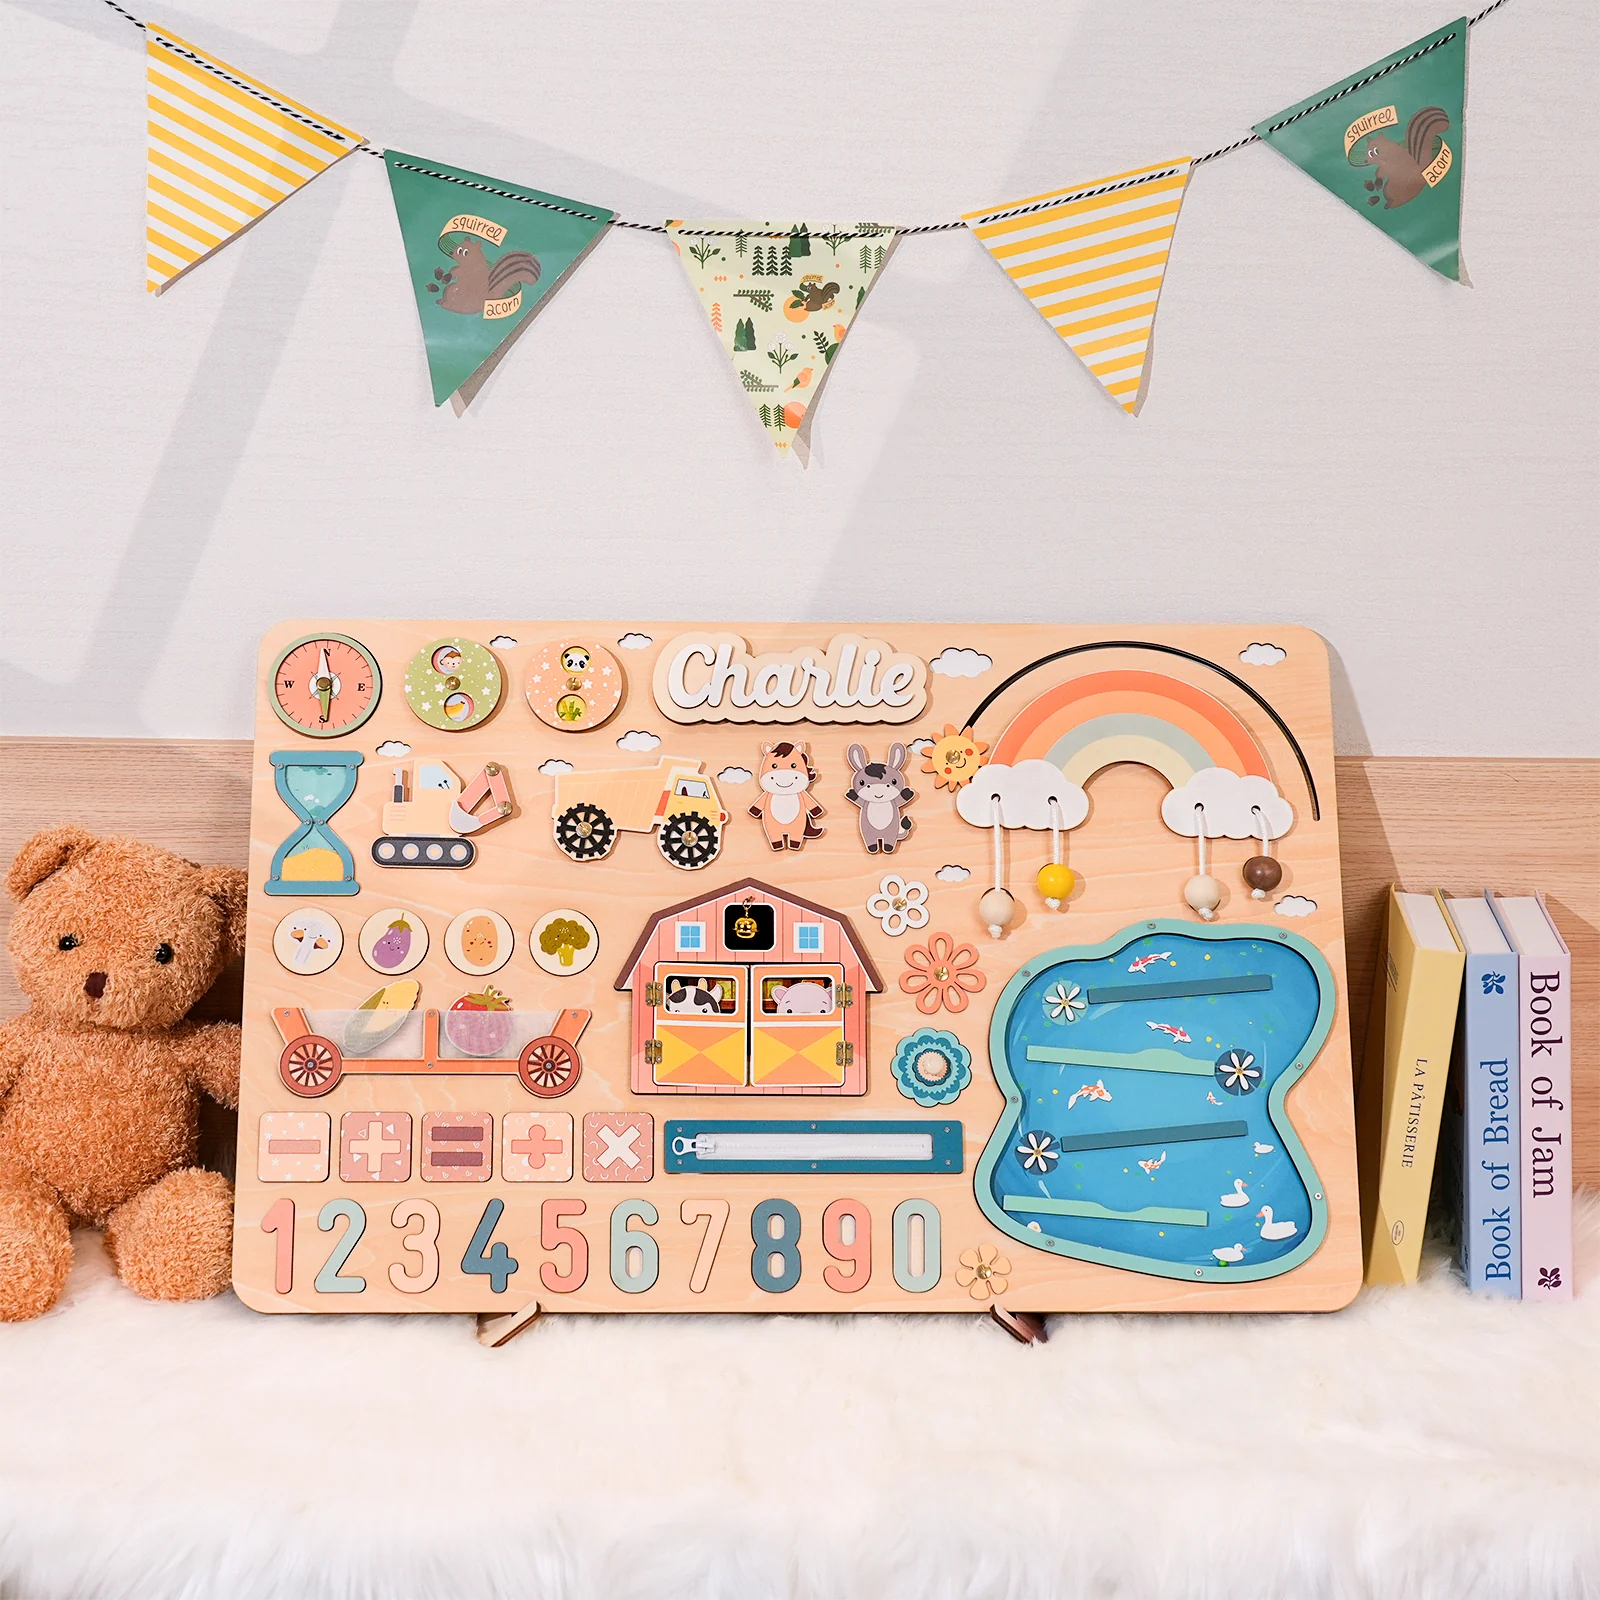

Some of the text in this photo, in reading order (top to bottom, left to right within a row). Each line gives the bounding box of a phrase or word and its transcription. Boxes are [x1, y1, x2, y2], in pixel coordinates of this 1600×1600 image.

[1347, 108, 1395, 143] squirrel
[1425, 148, 1451, 183] acorn
[452, 216, 502, 242] squirrel
[486, 297, 520, 317] acorn
[322, 648, 332, 657] N
[284, 680, 295, 689] W
[357, 683, 366, 692] E
[667, 643, 916, 709] Charlie
[319, 714, 327, 723] S
[1530, 970, 1564, 1198] Book of Jam
[1401, 1058, 1428, 1169] LA PÂTISSERIE
[1480, 1058, 1512, 1281] Book of Bread
[261, 1198, 942, 1294] 1 2 3 4 5 6 7 8 9 0
